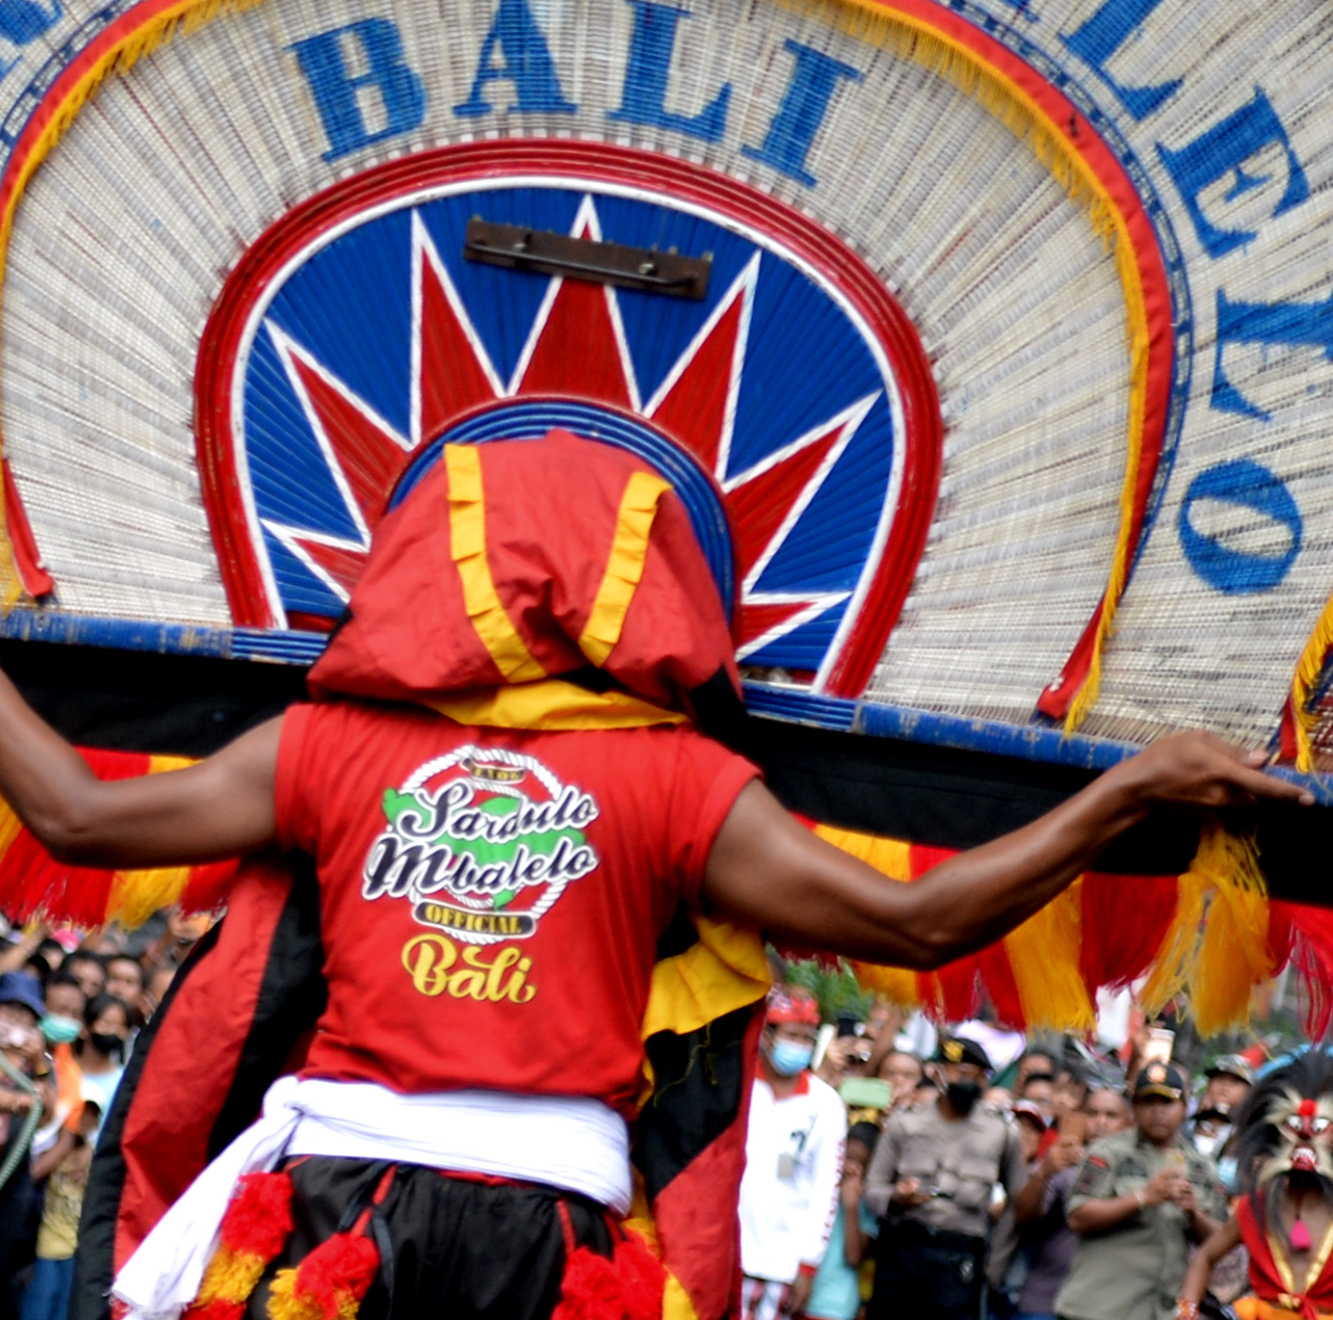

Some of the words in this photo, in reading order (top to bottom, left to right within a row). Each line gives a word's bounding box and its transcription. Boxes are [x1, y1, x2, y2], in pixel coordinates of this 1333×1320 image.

[398, 781, 596, 841] Sardulo
[364, 836, 596, 896] Mbalelo
[425, 903, 523, 935] OFFICIAL
[402, 934, 536, 1004] Bali
